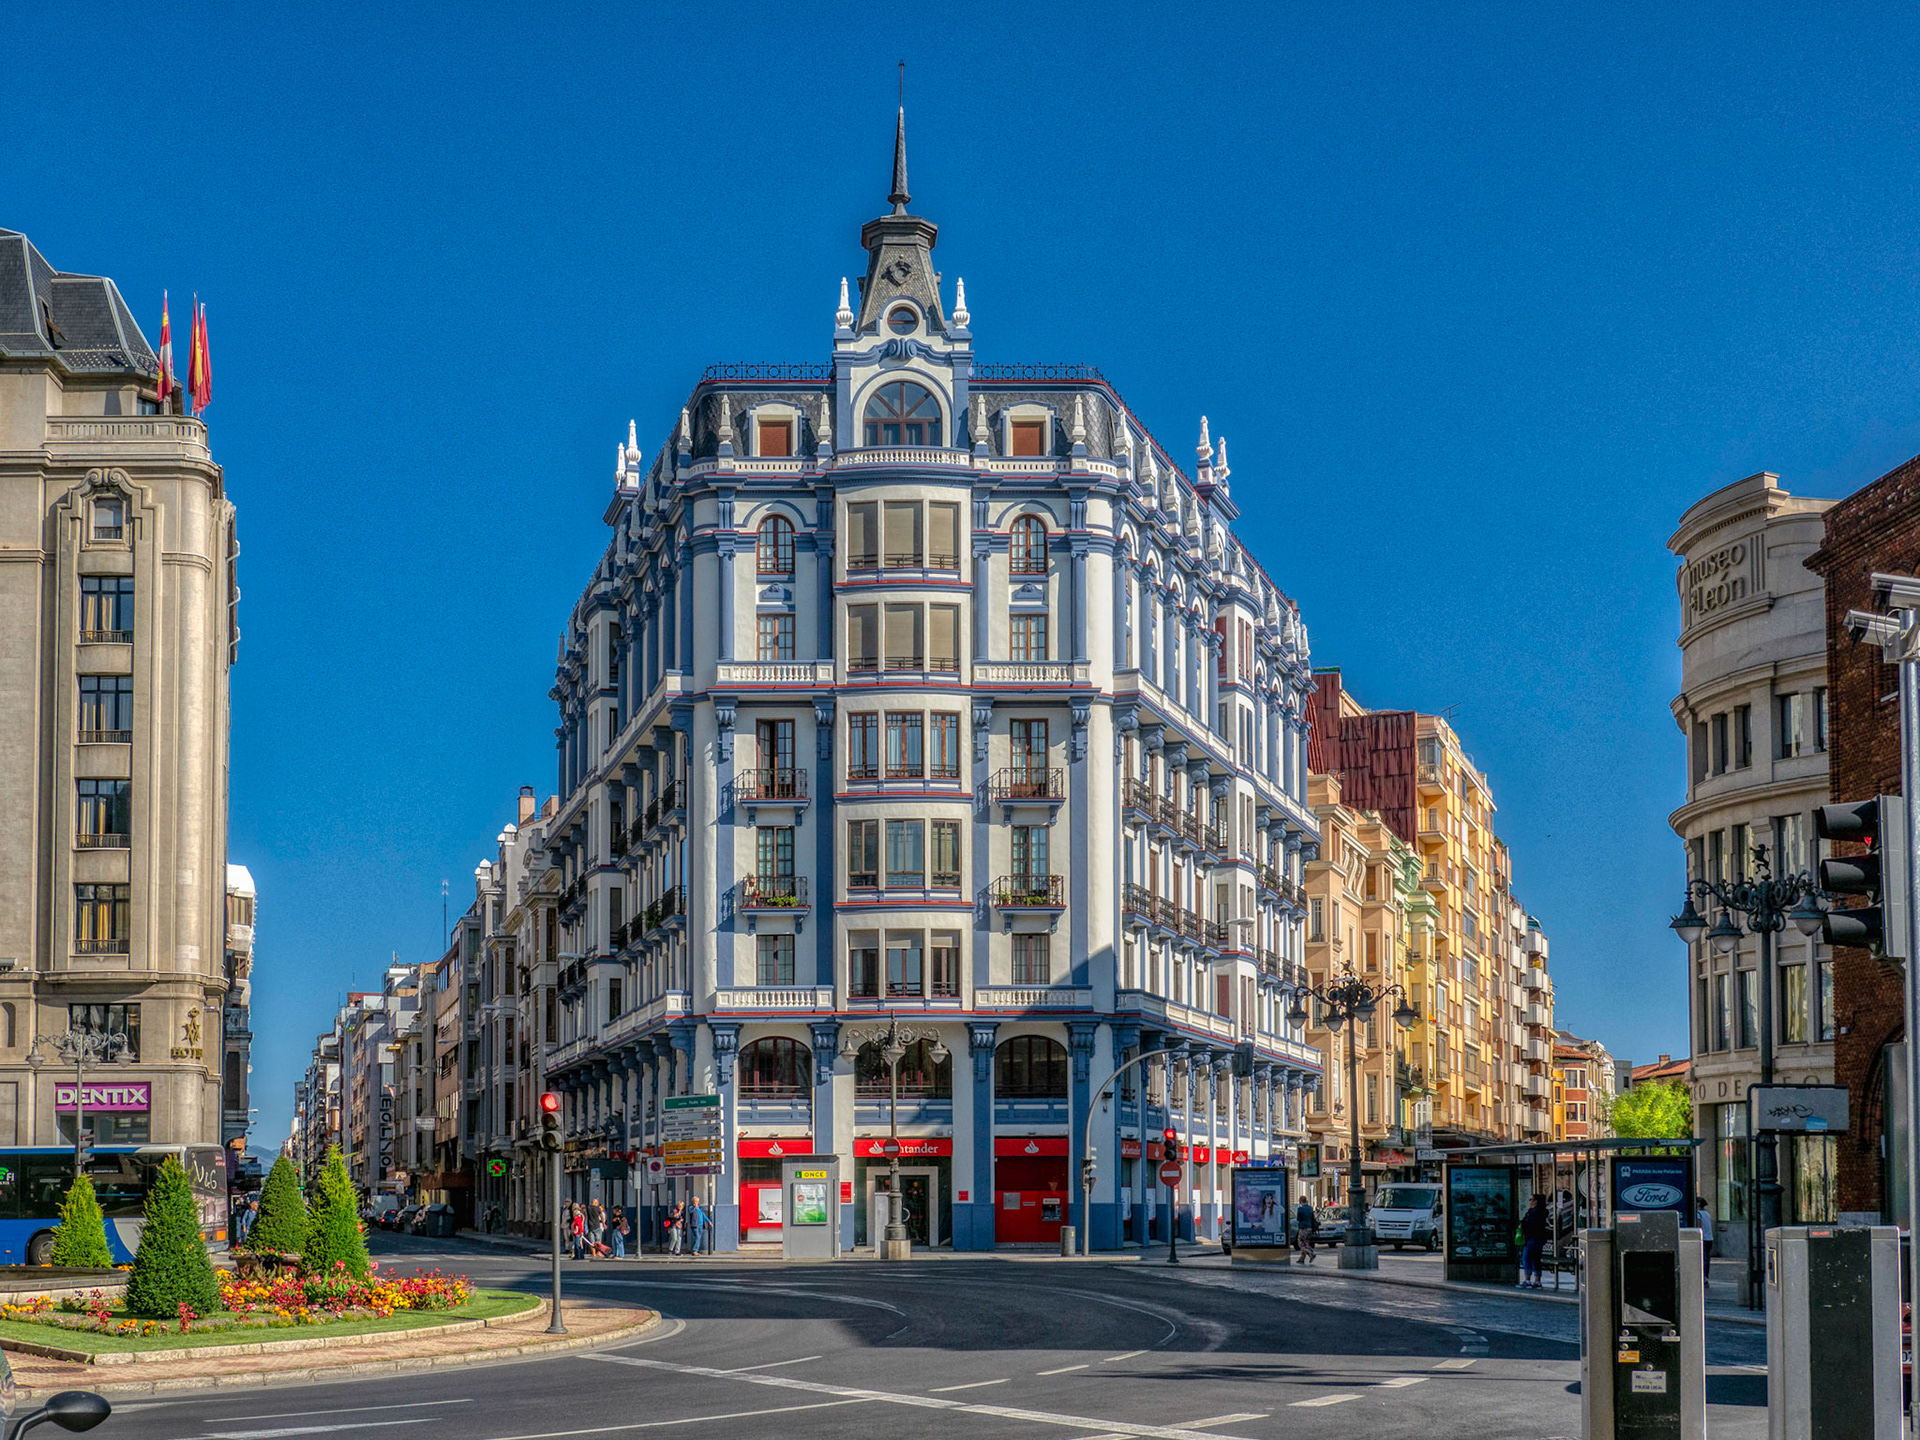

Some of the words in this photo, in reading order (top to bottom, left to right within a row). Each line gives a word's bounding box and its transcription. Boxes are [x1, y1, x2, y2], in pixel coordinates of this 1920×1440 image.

[1689, 544, 1745, 588] museo
[1698, 571, 1745, 615] León
[56, 1088, 149, 1105] DENTIX
[1718, 1080, 1742, 1099] DE
[900, 1142, 939, 1154] ntander
[1634, 1187, 1670, 1203] Ford
